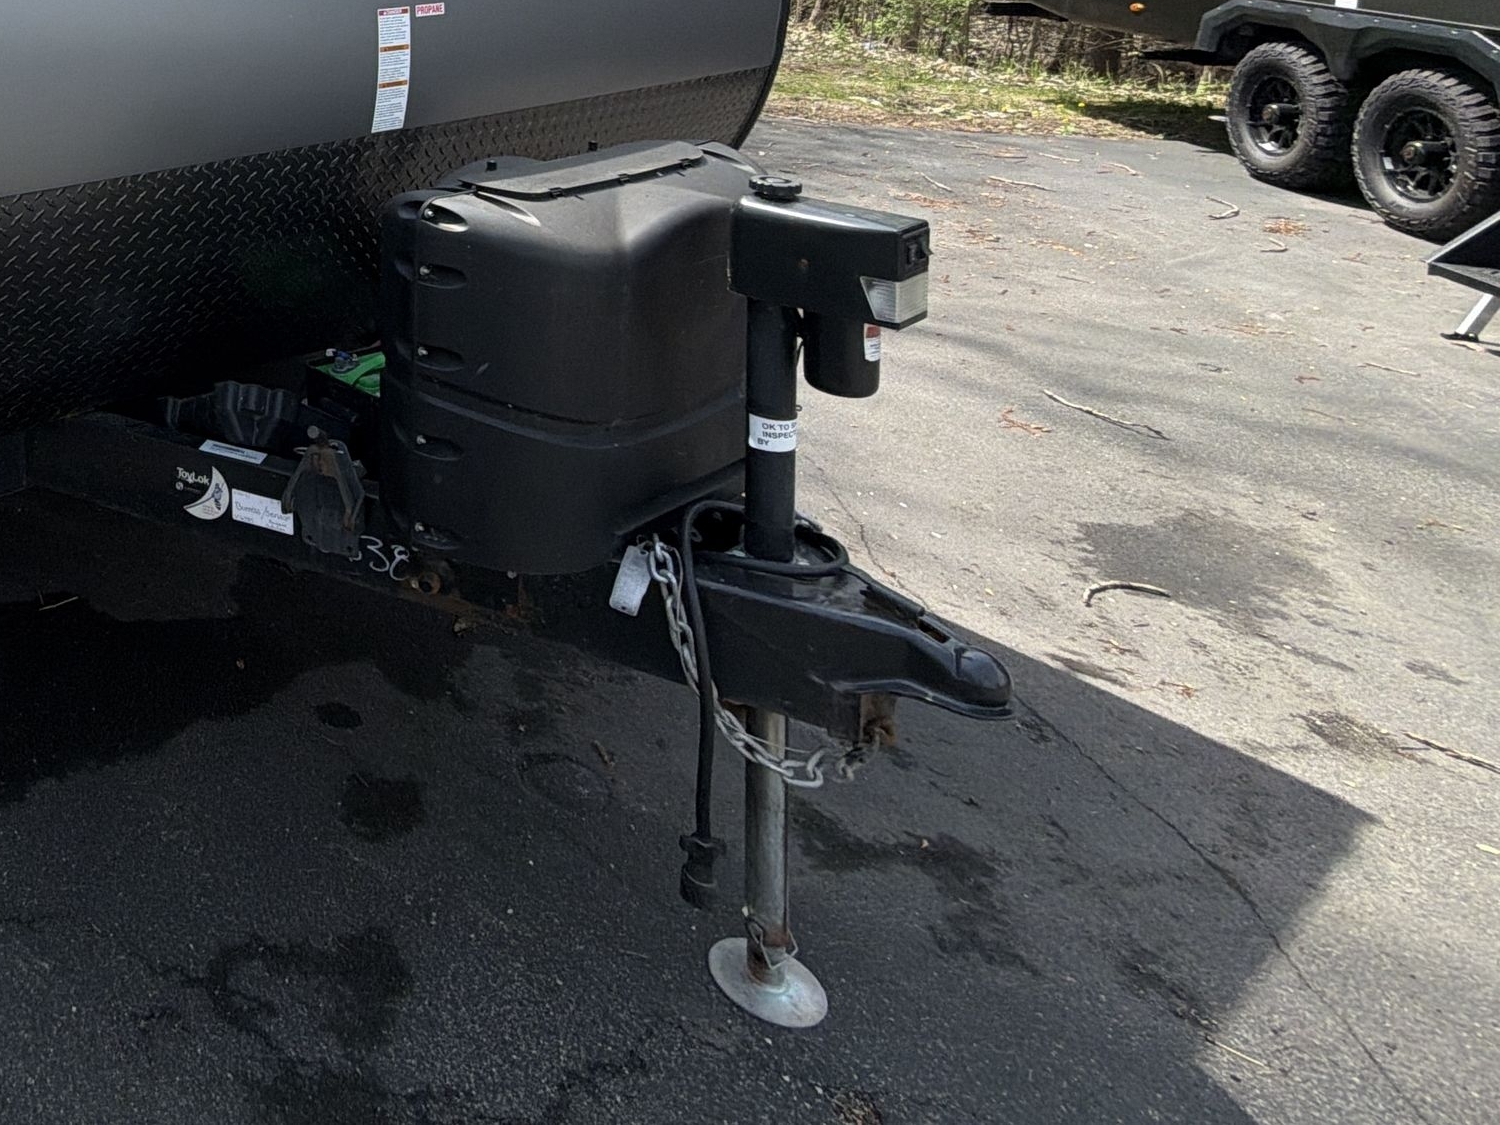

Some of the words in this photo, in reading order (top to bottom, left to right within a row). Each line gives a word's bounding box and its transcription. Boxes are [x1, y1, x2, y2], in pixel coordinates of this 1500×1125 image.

[416, 4, 443, 15] PROPANE
[761, 422, 776, 431] OK
[757, 437, 770, 446] BY
